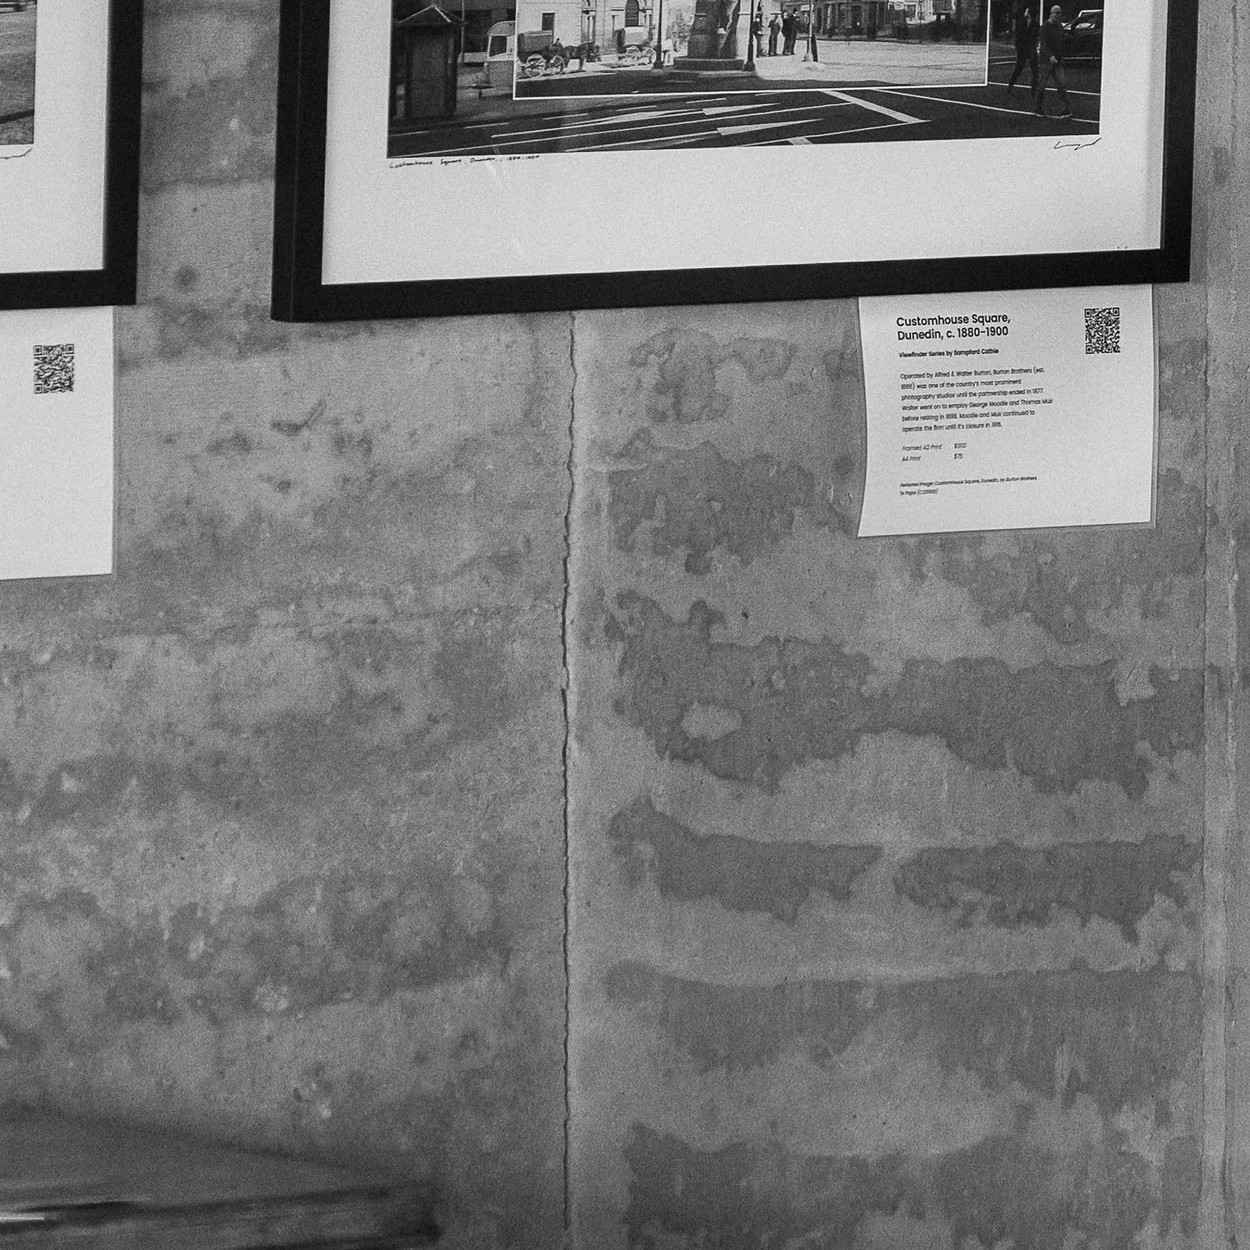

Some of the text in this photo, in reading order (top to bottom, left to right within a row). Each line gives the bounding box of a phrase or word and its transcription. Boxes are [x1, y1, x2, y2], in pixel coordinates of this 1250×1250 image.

[896, 314, 1011, 326] Customhouse Square,
[897, 329, 944, 340] Dunedin,
[946, 330, 955, 338] c.
[978, 390, 1008, 398] partnership
